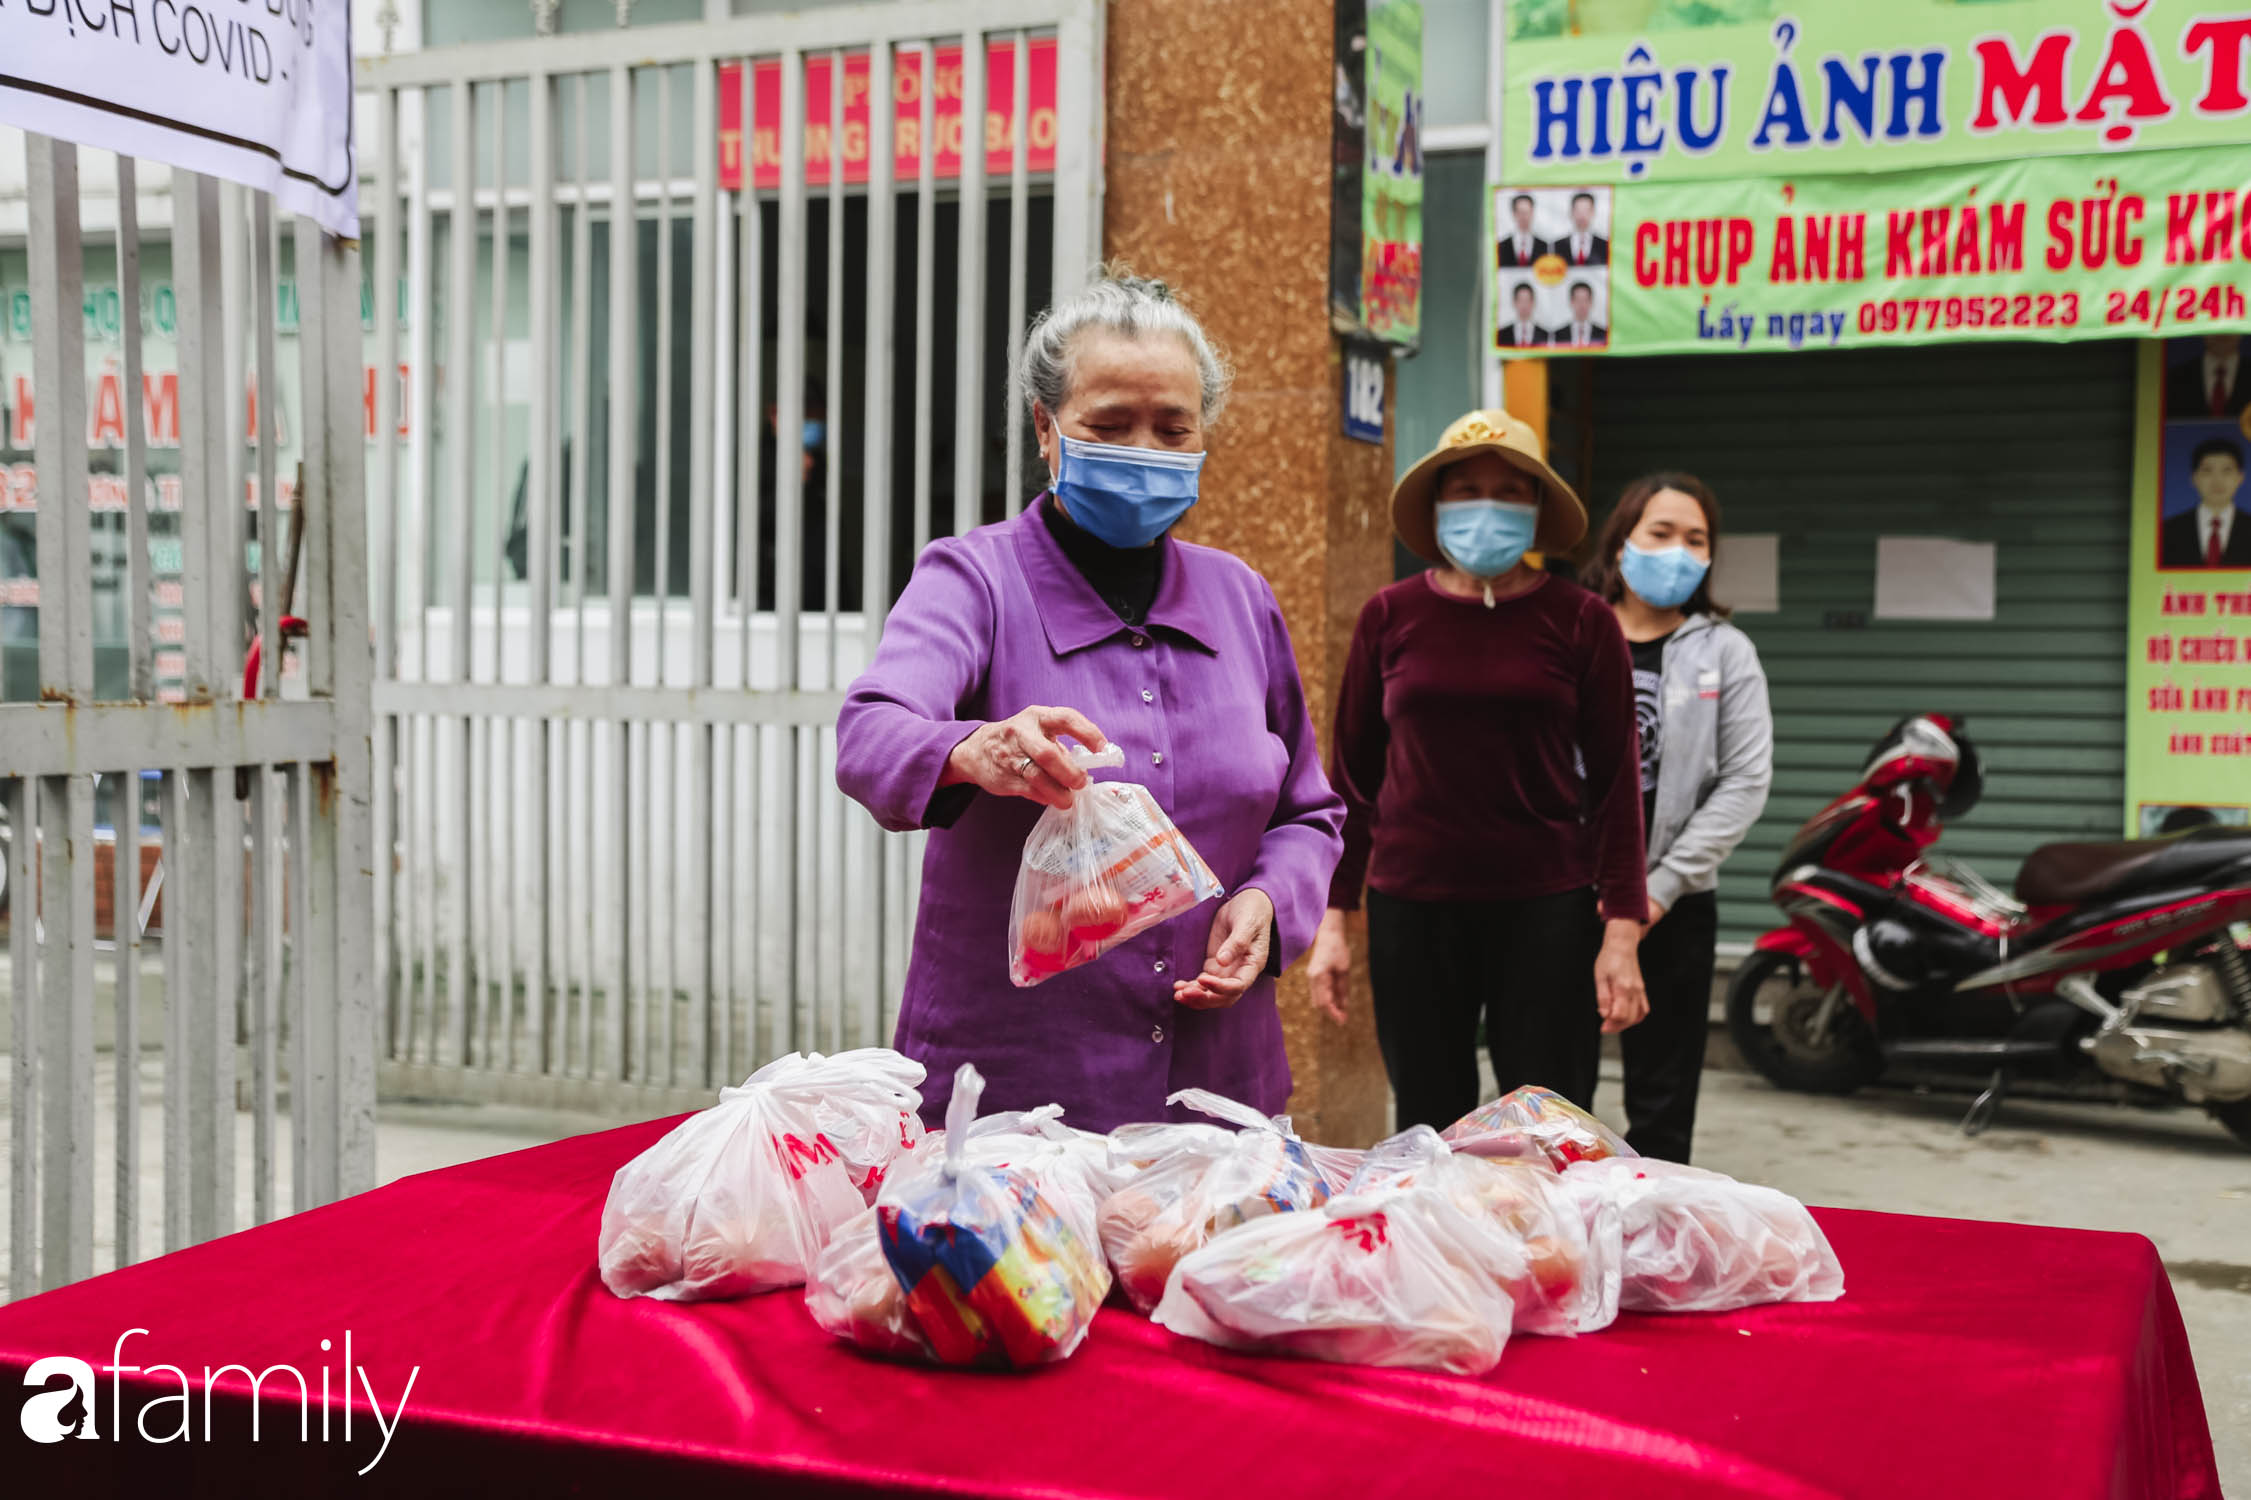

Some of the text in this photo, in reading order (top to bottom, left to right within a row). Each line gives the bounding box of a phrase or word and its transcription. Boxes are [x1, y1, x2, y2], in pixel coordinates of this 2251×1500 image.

[1532, 46, 1729, 174] HIỆU
[1753, 22, 1945, 146] ẢNH
[1971, 0, 2251, 142] MẶT
[1634, 217, 1755, 305] CHỤP
[1769, 183, 1866, 285] ẢNH
[1884, 186, 2026, 280] KHÁM
[2045, 178, 2145, 271] SỨC
[1767, 312, 1846, 348] ngay
[1857, 291, 2080, 334] 0977952223
[2105, 284, 2246, 331] 24/24h
[1349, 357, 1383, 426] 182
